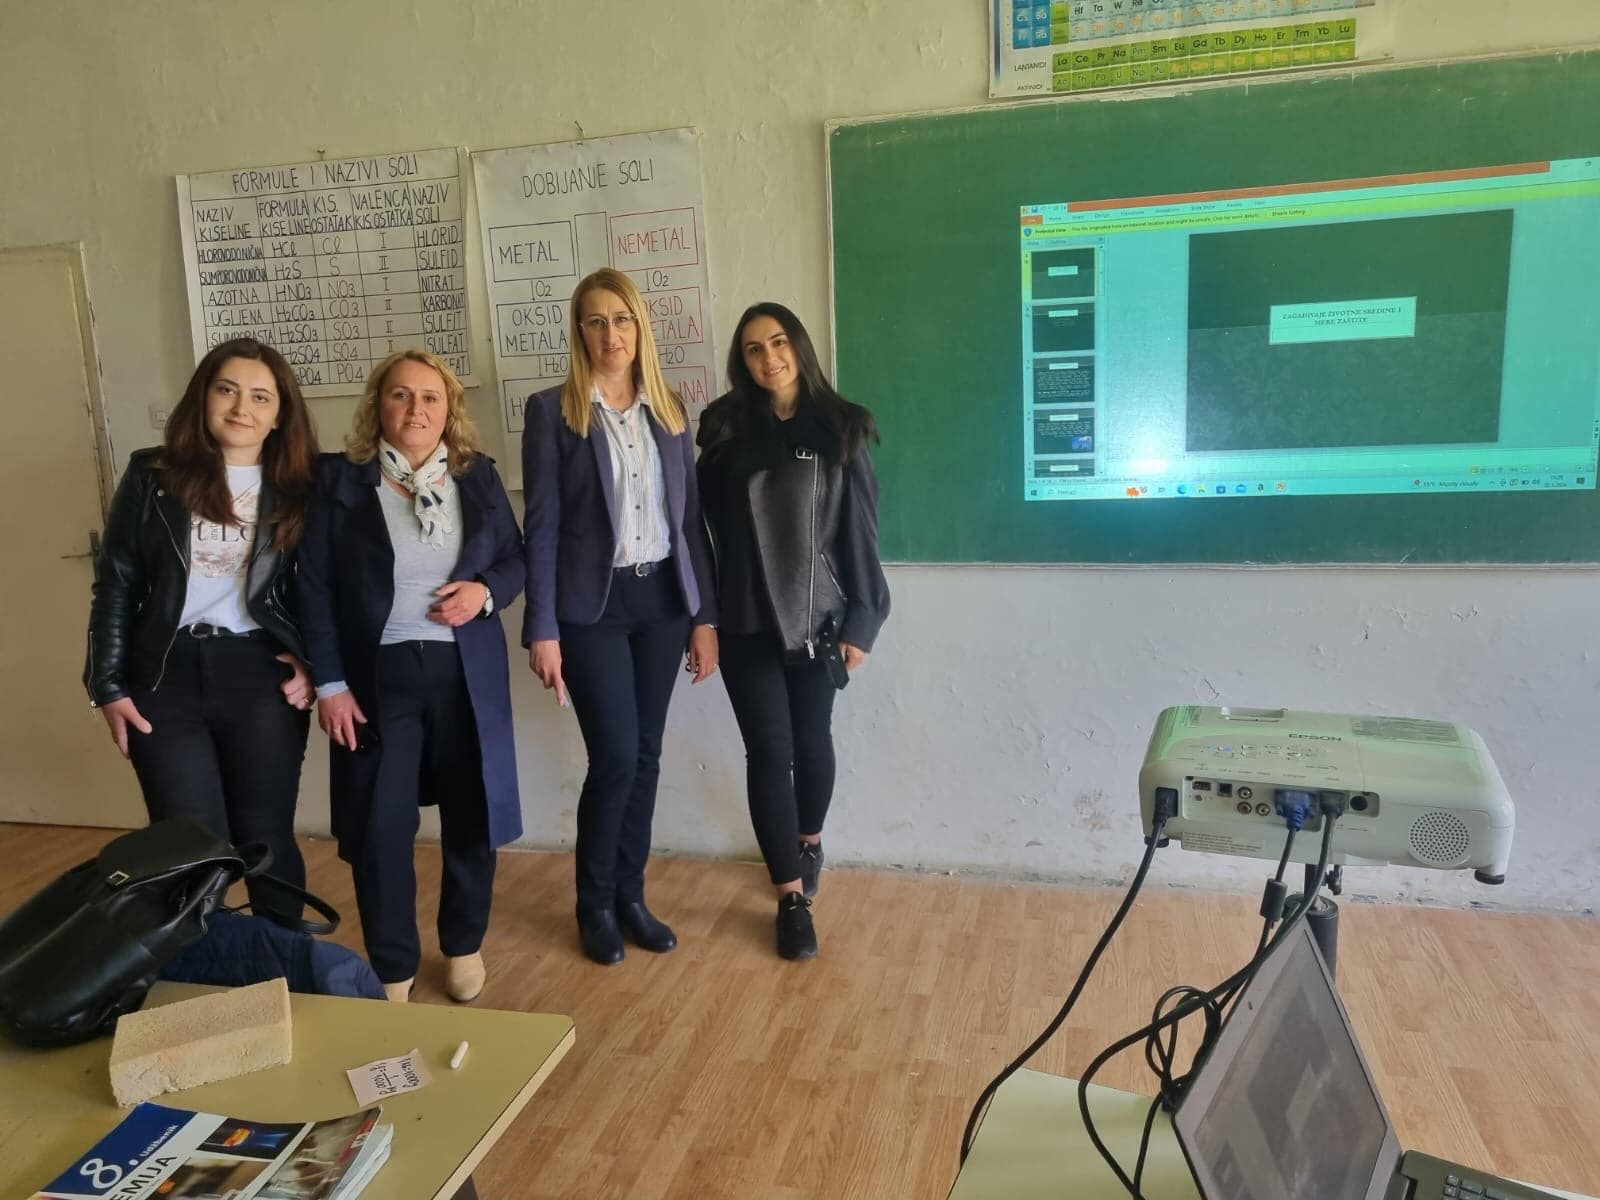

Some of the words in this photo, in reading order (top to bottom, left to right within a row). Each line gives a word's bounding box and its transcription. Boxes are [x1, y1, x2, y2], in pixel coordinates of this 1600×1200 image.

[1215, 37, 1226, 46] Tb
[1234, 35, 1247, 45] Dy
[1254, 33, 1267, 41] Ho
[1276, 31, 1286, 40] Er
[1295, 29, 1310, 38] Tm
[1317, 27, 1330, 36] Yb
[1339, 24, 1350, 33] Lu
[231, 167, 300, 193] FORMULE
[325, 158, 380, 182] NAZIVI
[388, 153, 419, 178] SOLI
[522, 163, 608, 198] DOBIJANJE
[618, 158, 653, 185] SOLI
[196, 206, 234, 222] NAZIV
[258, 199, 309, 218] FORMULA
[352, 187, 411, 210] VALENCA
[412, 183, 450, 205] NAZIV
[199, 223, 252, 241] KISELINE
[261, 218, 311, 236] KISELINE
[310, 213, 353, 233] OSTATAK
[373, 208, 413, 228] OSTATKA
[415, 205, 440, 225] SOLI
[322, 236, 341, 254] Cl
[416, 225, 459, 248] HLORID
[499, 240, 559, 265] METAL
[617, 226, 692, 255] NEMETAL
[329, 256, 340, 276] S
[419, 248, 458, 270] SULFID
[208, 287, 260, 306] AZOTNA
[328, 279, 355, 299] NO3
[421, 274, 454, 292] NITRAT
[535, 280, 552, 297] O2
[652, 270, 669, 287] O2
[329, 299, 359, 318] CO3
[422, 293, 464, 312] KARBONAT
[511, 304, 563, 327] OKSID
[333, 321, 360, 340] SO3
[425, 310, 462, 334] SULFIT
[505, 329, 569, 352] METALA
[650, 315, 700, 342] ETALA
[427, 333, 464, 354] SULFAT
[1288, 733, 1342, 741] EPSON
[109, 1154, 178, 1200] EMIJA
